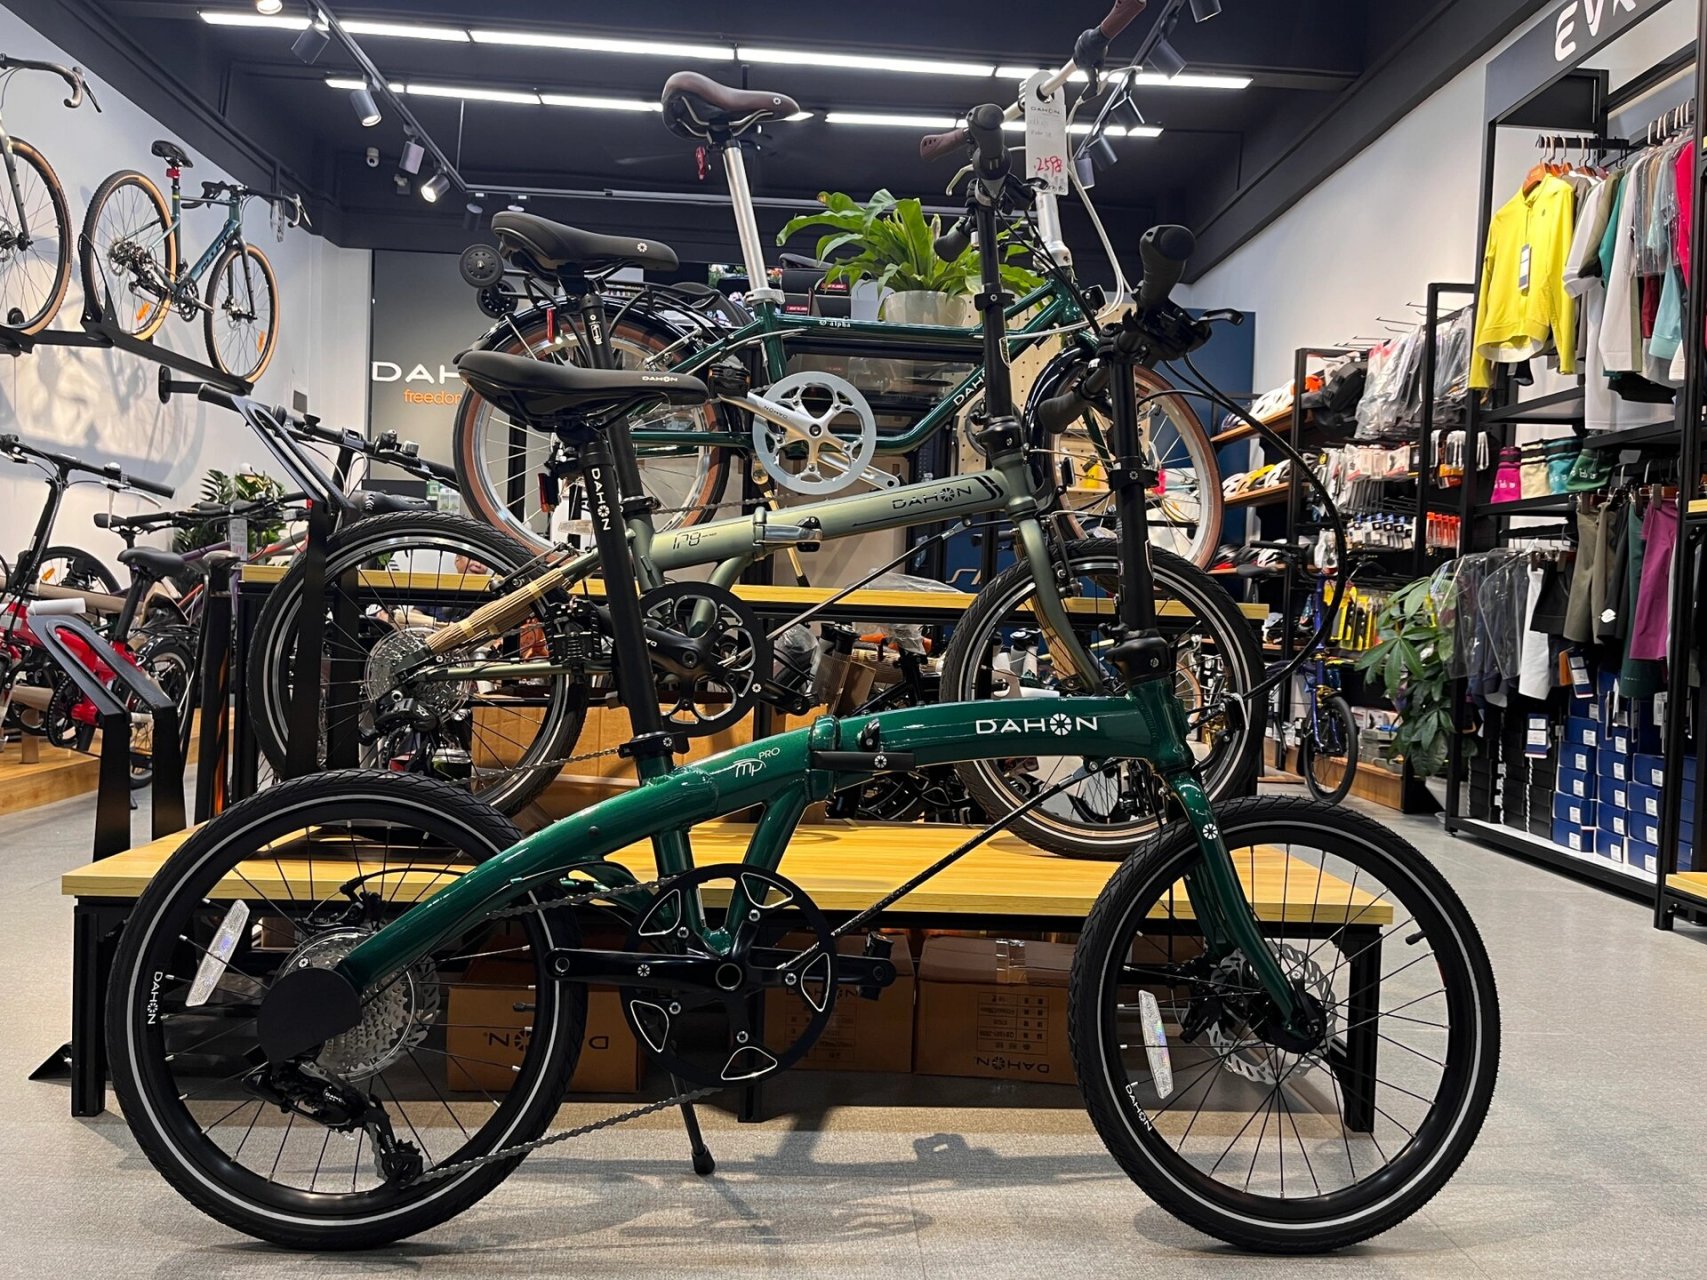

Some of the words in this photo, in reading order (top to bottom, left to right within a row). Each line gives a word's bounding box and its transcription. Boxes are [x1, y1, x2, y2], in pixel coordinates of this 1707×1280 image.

[829, 320, 851, 328] alpha
[372, 361, 461, 384] DAH
[641, 375, 678, 383] DAHON
[953, 369, 985, 406] DAH
[591, 468, 611, 531] DAHON
[892, 486, 972, 509] DAHON
[976, 713, 1098, 736] DAHON
[758, 747, 780, 760] PRO
[147, 971, 163, 1024] DAHON
[976, 1056, 1050, 1073] DAHON
[1125, 1084, 1152, 1131] DAHON
